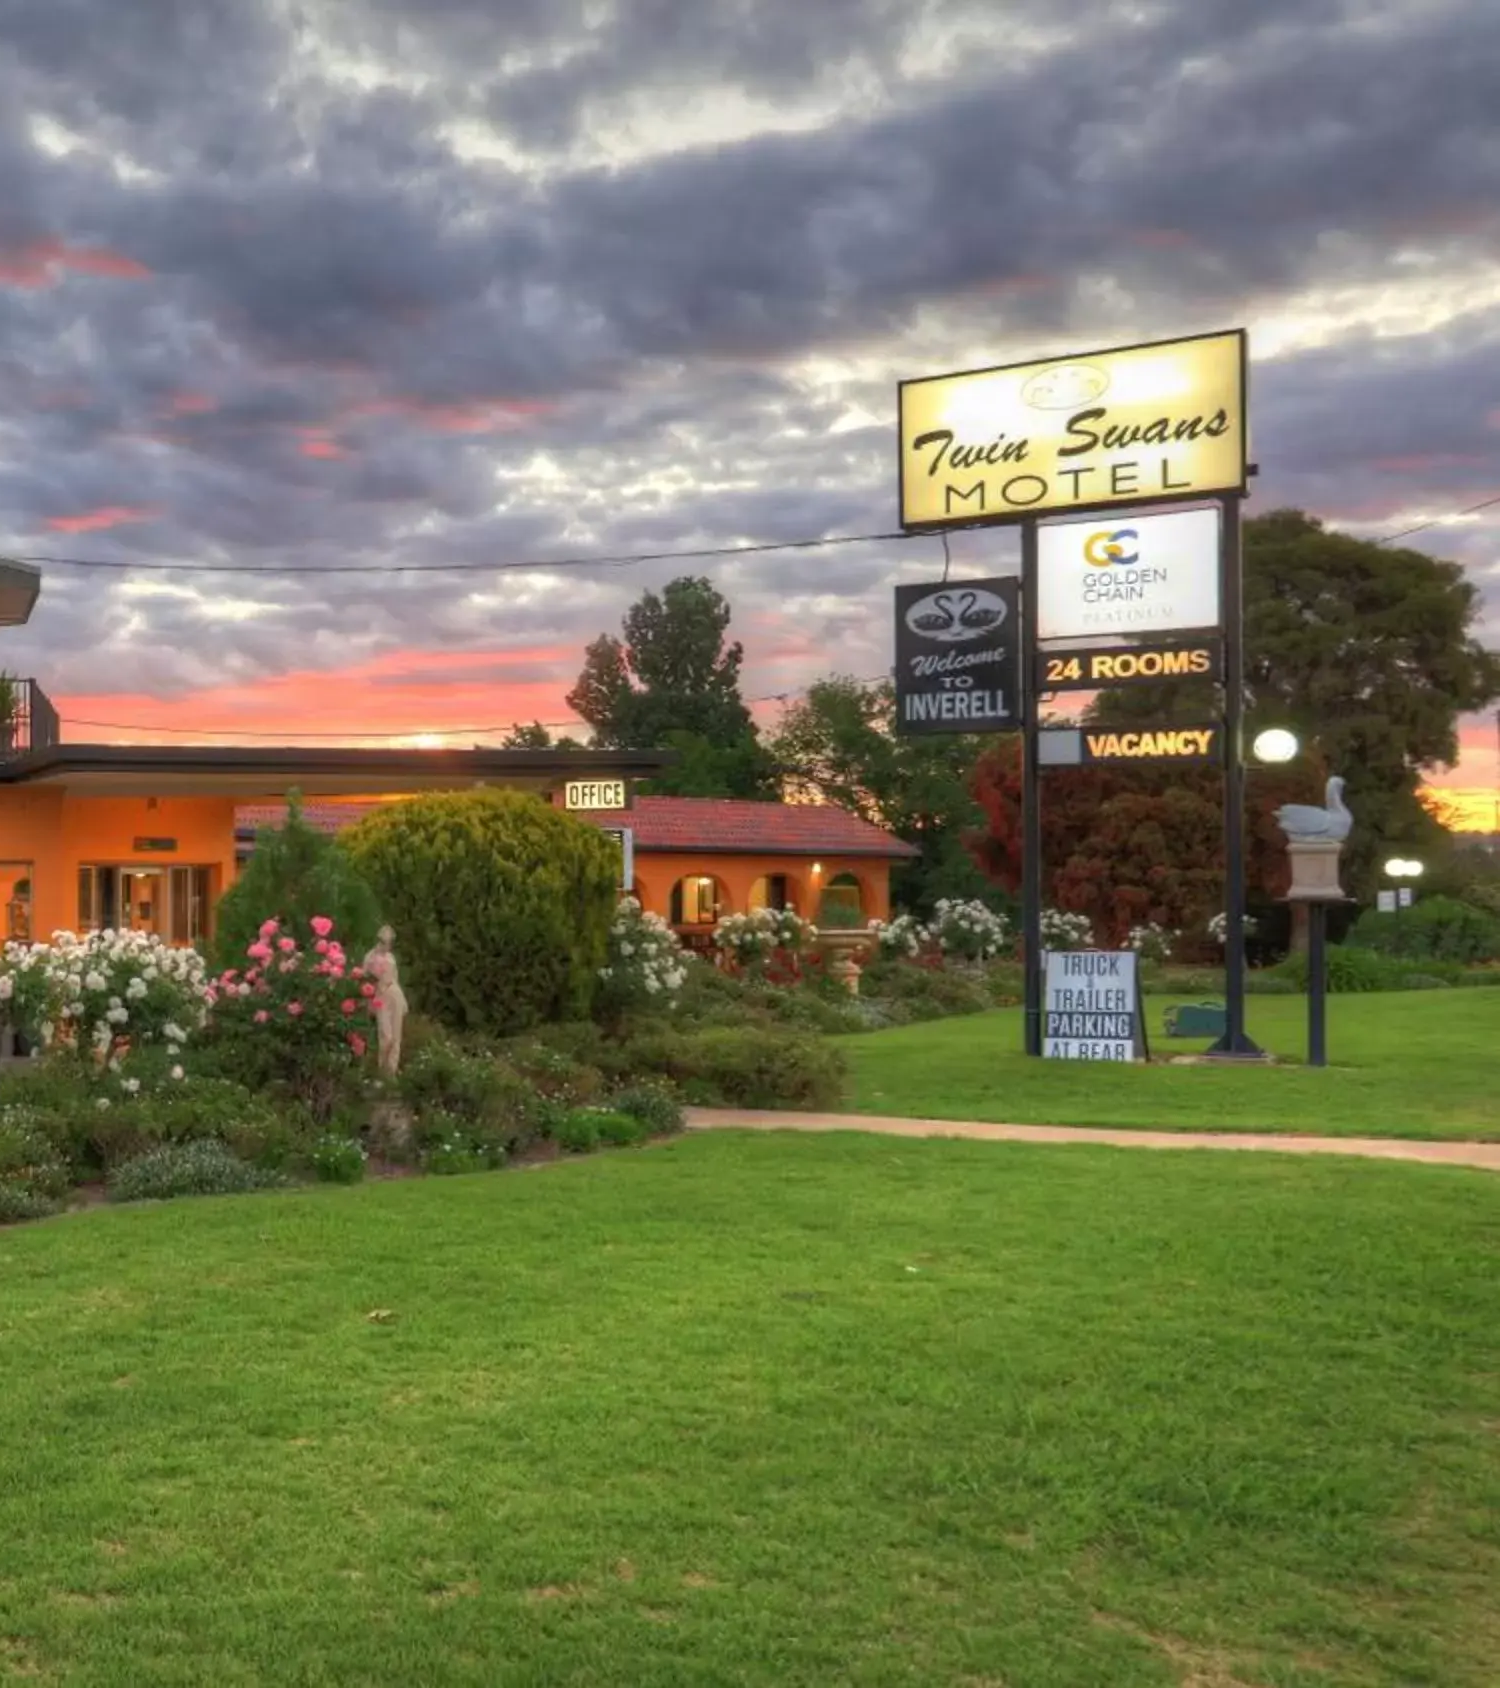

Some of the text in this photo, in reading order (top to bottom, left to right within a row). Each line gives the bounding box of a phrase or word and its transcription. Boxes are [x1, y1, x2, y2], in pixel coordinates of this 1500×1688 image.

[913, 407, 1230, 476] Twin Swans
[945, 458, 1191, 514] MOTEL
[1083, 568, 1167, 587] GOLDEN
[1083, 585, 1144, 603] CHAIN
[910, 647, 1005, 676] Welcome
[1046, 650, 1211, 681] 24 ROOMS
[939, 675, 974, 689] TO
[905, 690, 1010, 721] INVERELL
[1086, 729, 1214, 758] VACANCY
[569, 784, 622, 806] OFFICE
[1062, 955, 1119, 977] TRUCK
[1053, 989, 1126, 1011] TRAILER
[1047, 1013, 1130, 1037] PARKING
[1051, 1041, 1125, 1060] AT REAR
